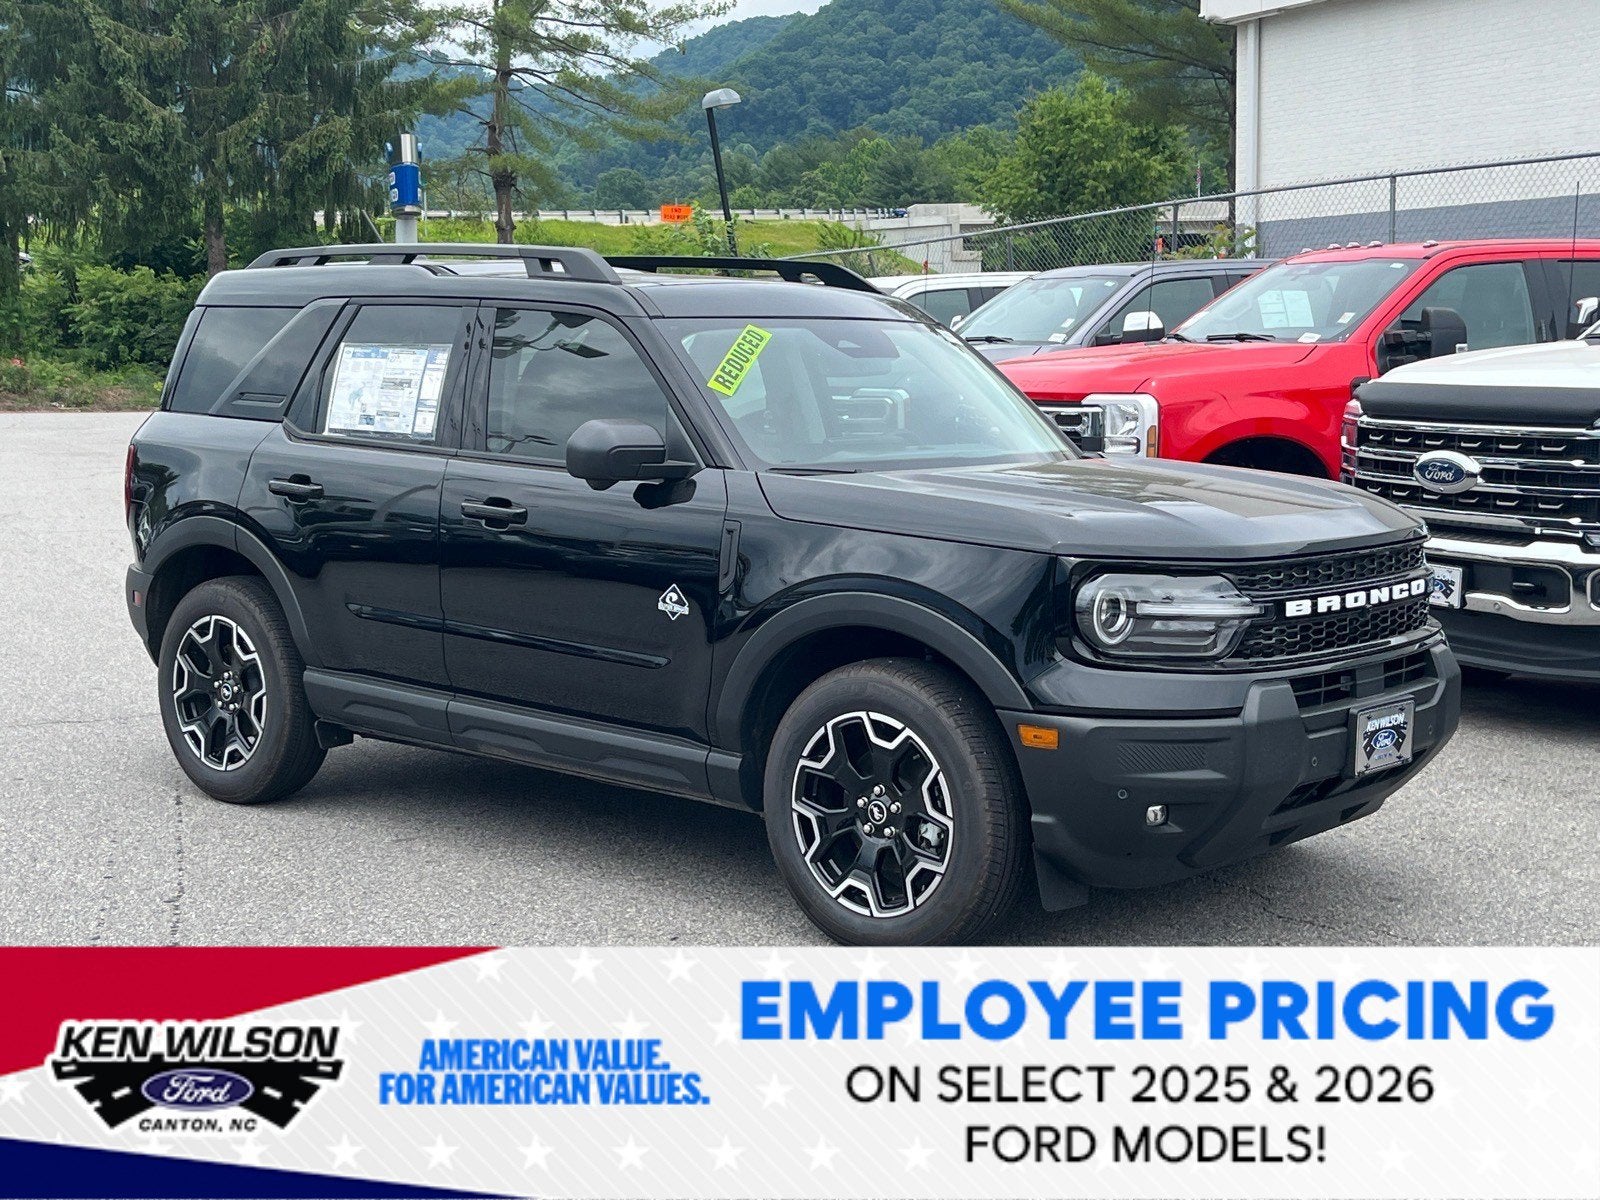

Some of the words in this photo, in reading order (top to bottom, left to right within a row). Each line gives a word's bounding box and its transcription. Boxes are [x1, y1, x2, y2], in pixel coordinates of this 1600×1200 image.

[713, 329, 765, 391] REDUCED
[1424, 461, 1456, 482] Ford
[1284, 578, 1427, 618] BRONCO
